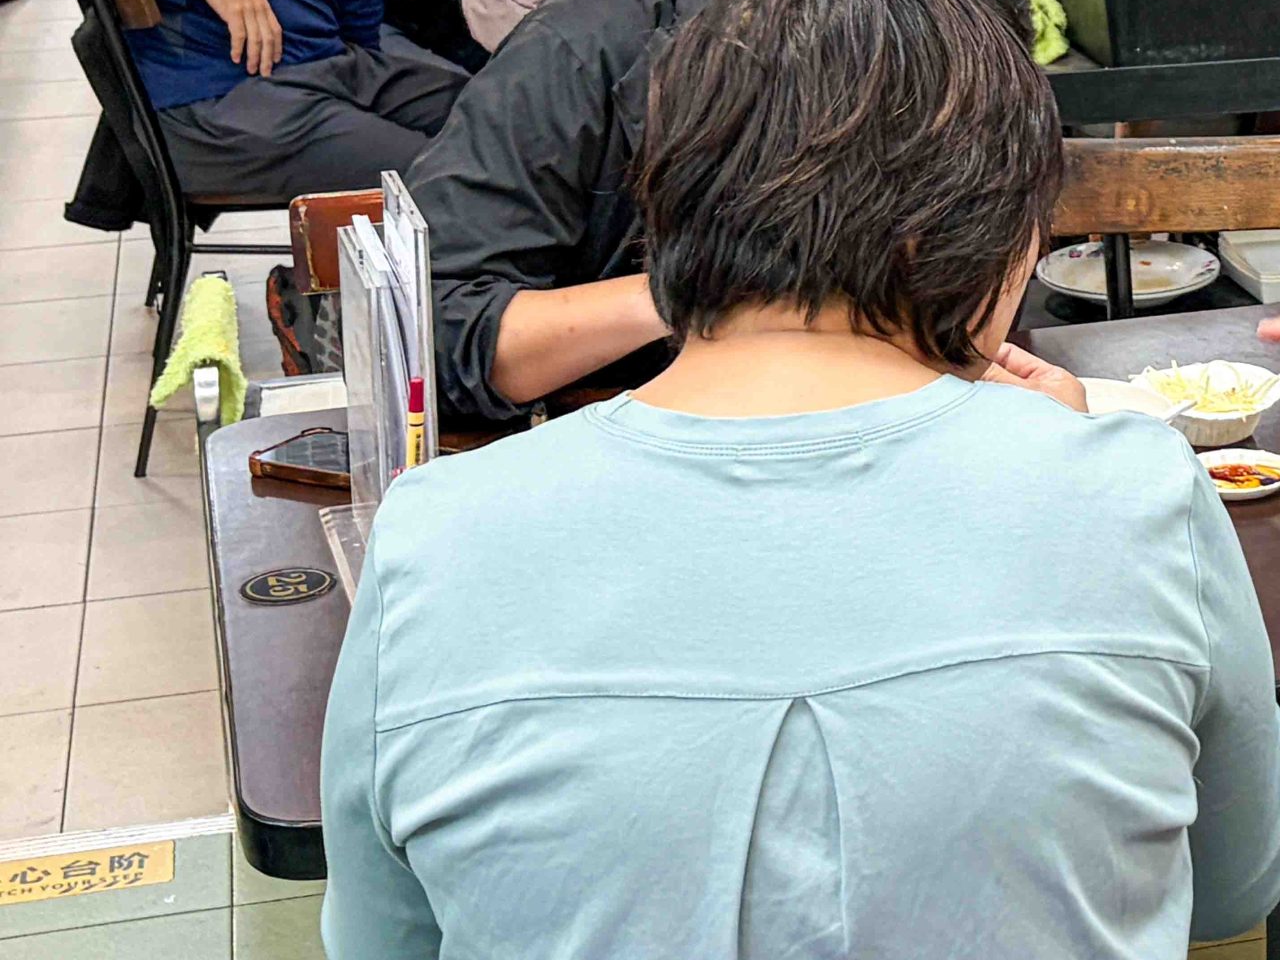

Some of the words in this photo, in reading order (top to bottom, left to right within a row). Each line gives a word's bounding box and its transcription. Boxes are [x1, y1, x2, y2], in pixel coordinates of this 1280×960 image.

[267, 572, 309, 597] 25
[0, 851, 150, 886] 心台阶
[40, 879, 93, 892] YOUR
